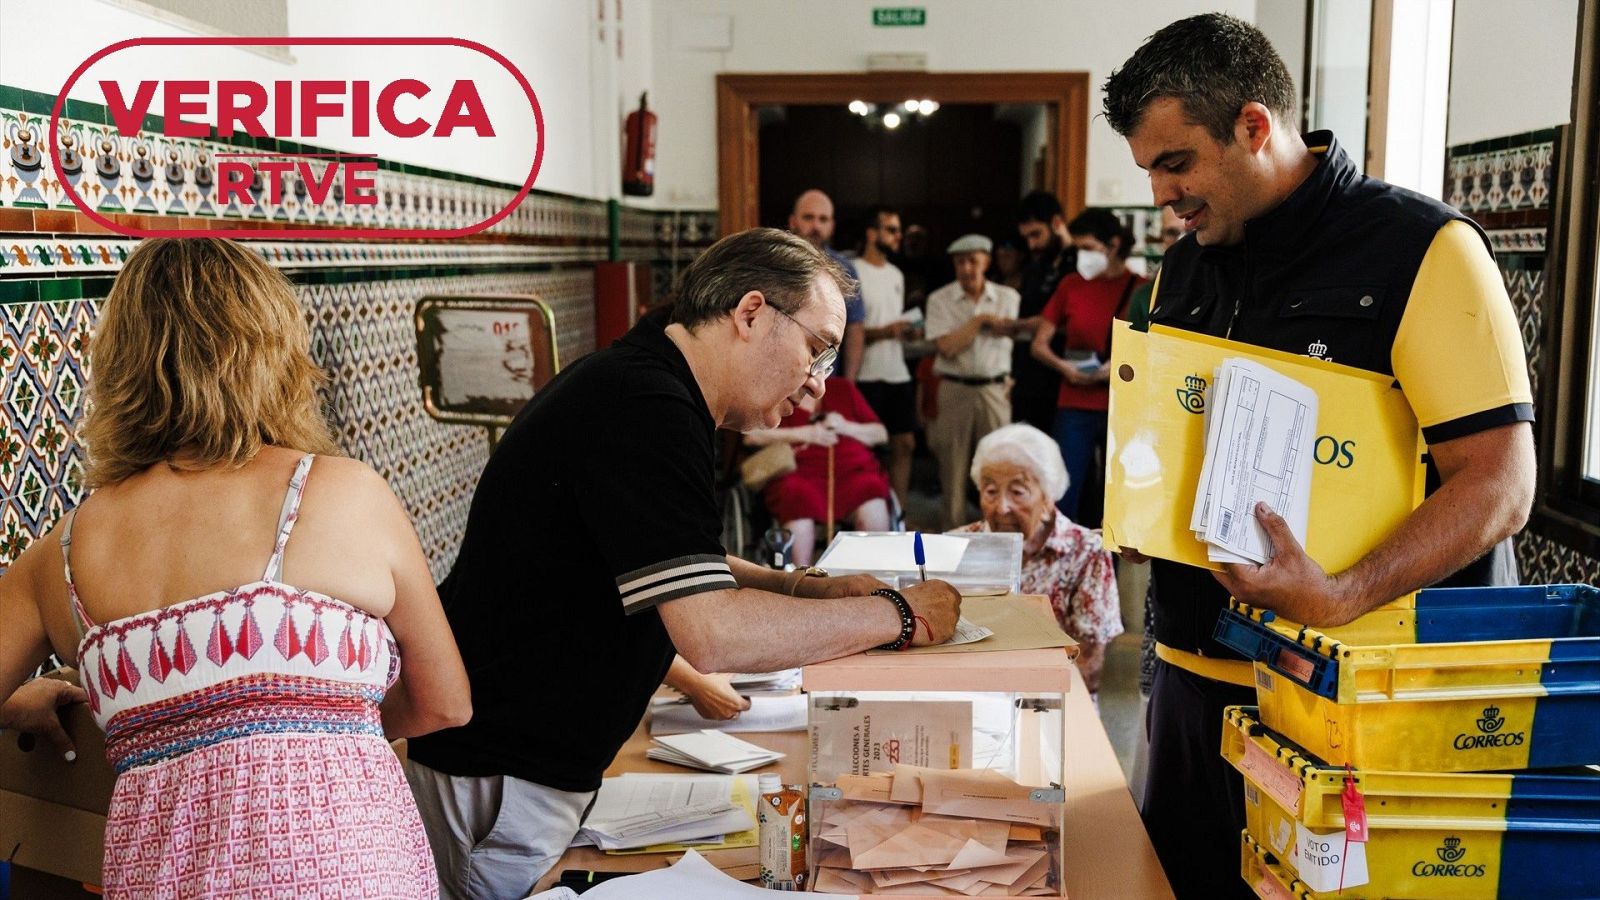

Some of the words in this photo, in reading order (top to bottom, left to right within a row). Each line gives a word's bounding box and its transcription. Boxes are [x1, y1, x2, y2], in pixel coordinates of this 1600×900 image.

[1453, 732, 1524, 750] CORREOS
[1306, 836, 1330, 852] VOTO
[1412, 861, 1486, 877] CORREOS
